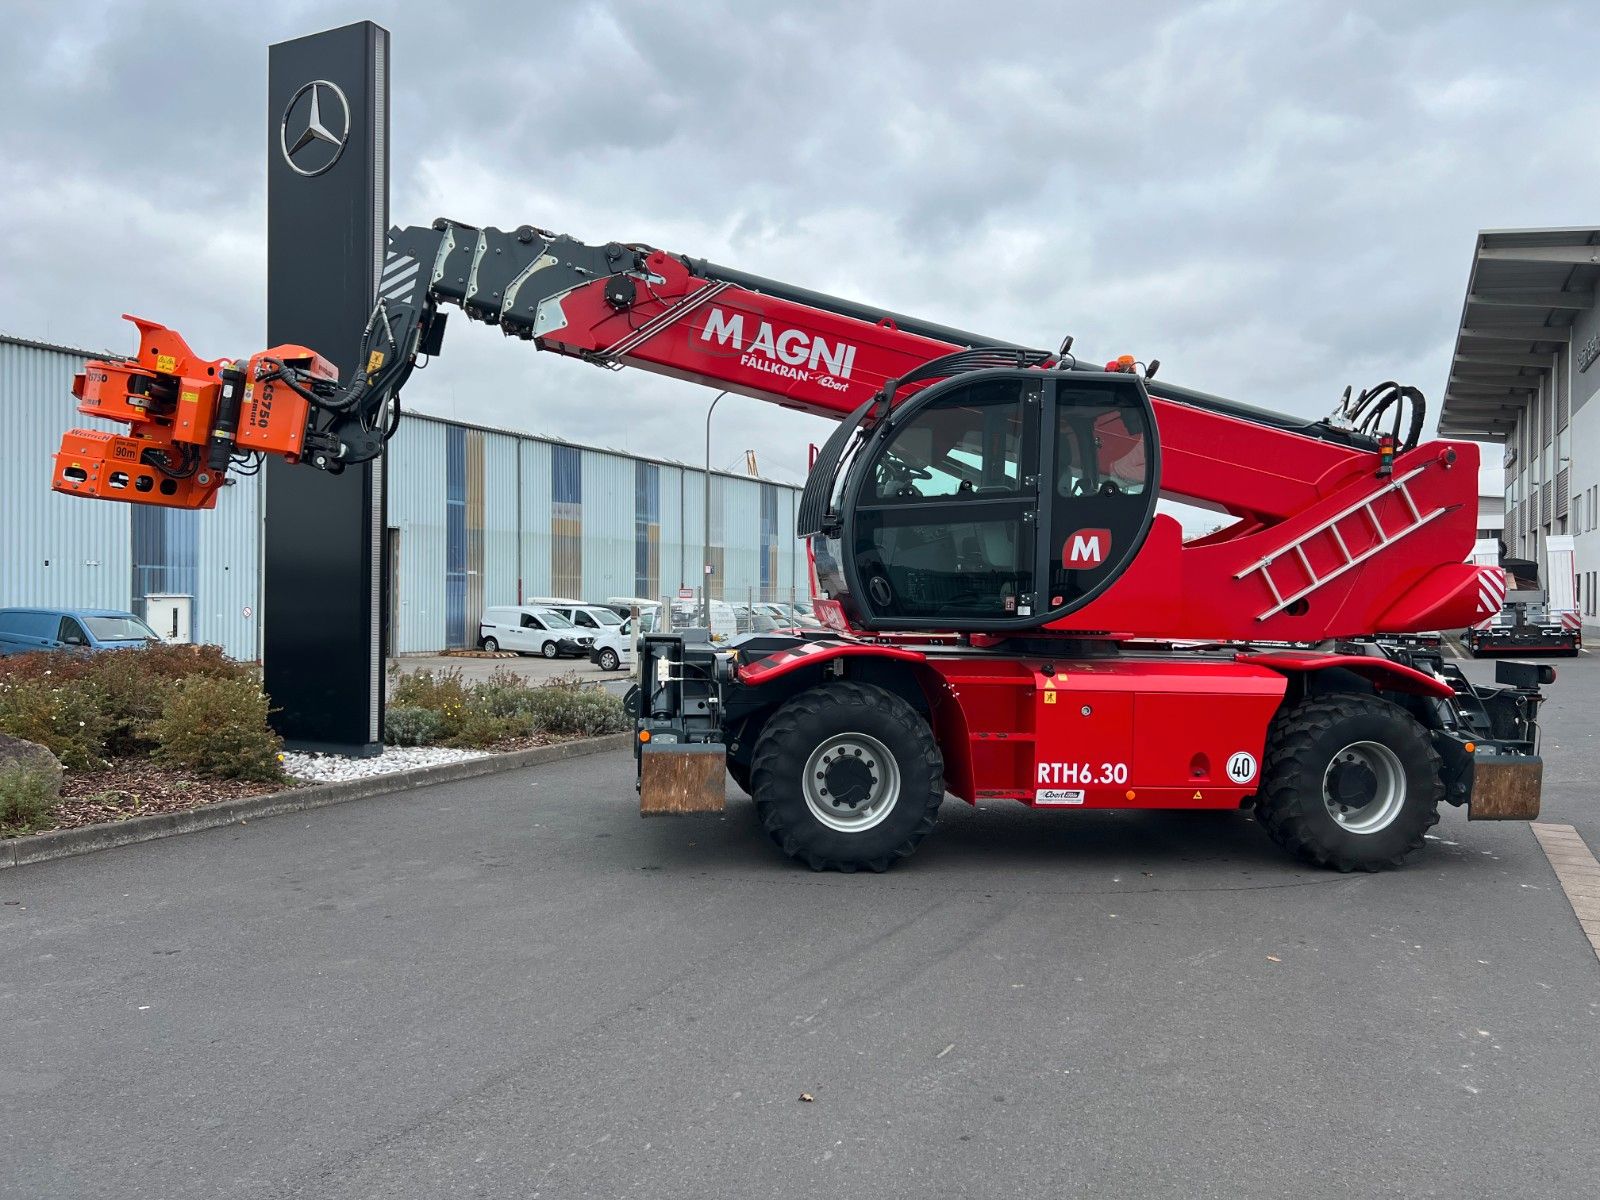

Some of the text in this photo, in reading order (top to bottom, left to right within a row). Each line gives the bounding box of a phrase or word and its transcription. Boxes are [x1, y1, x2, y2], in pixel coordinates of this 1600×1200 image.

[701, 308, 856, 379] MAGNI
[250, 399, 258, 426] smart
[115, 446, 136, 459] 90m
[1070, 535, 1101, 562] M
[1037, 763, 1128, 784] RTH6.30
[1232, 757, 1250, 777] 40
